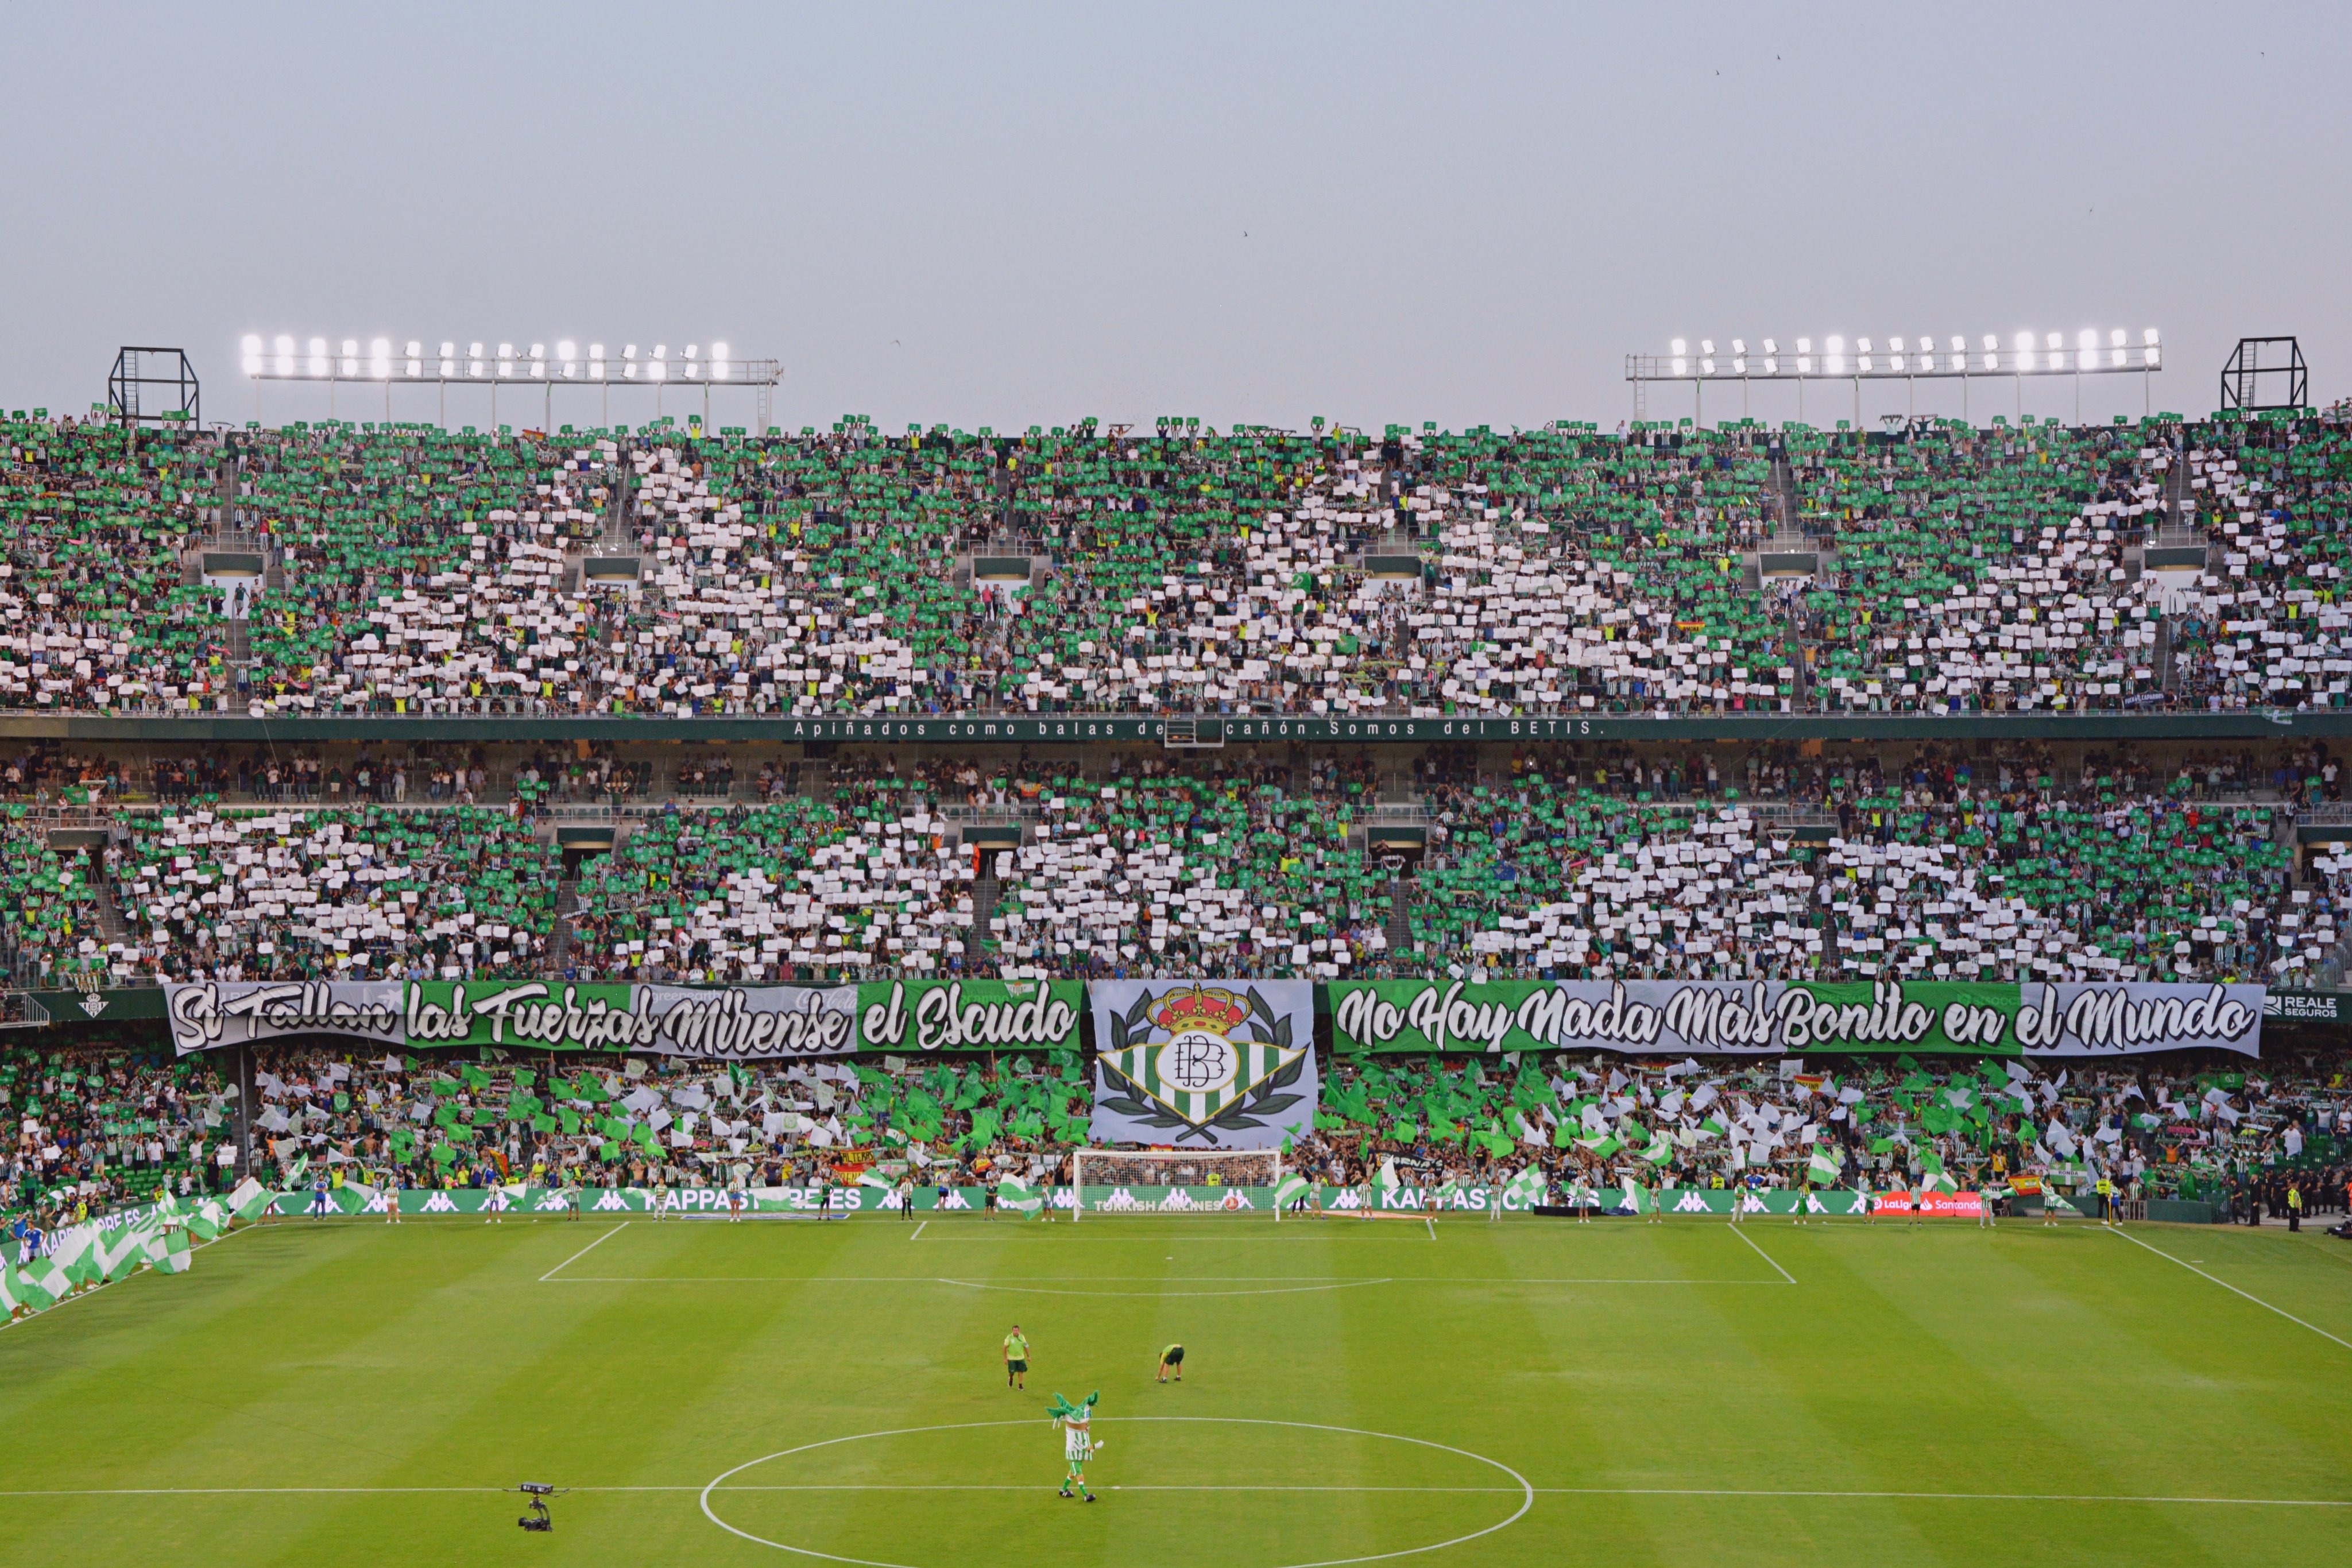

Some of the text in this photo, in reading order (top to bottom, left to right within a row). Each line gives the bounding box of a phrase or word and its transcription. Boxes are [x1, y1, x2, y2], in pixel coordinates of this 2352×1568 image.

[794, 721, 926, 737] Apiñados
[949, 723, 1015, 735] como
[1038, 722, 1114, 735] balas
[1137, 722, 1165, 735] de
[1444, 721, 1484, 735] del
[1510, 721, 1604, 735] BETIS.
[2284, 996, 2336, 1009] REALE
[172, 982, 225, 1050] Si
[405, 981, 475, 1042] las
[470, 983, 660, 1050] Fuerzas
[861, 979, 908, 1046] el
[916, 979, 1079, 1050] Escudo
[1336, 978, 2257, 1052] No Hay Nada Más Bonito en el Mundo
[2284, 1008, 2337, 1017] SEGUROS
[841, 1151, 874, 1162] ALTERAS
[1094, 1201, 1222, 1211] TURKISH AIRLINES
[1935, 1199, 1982, 1210] Santande
